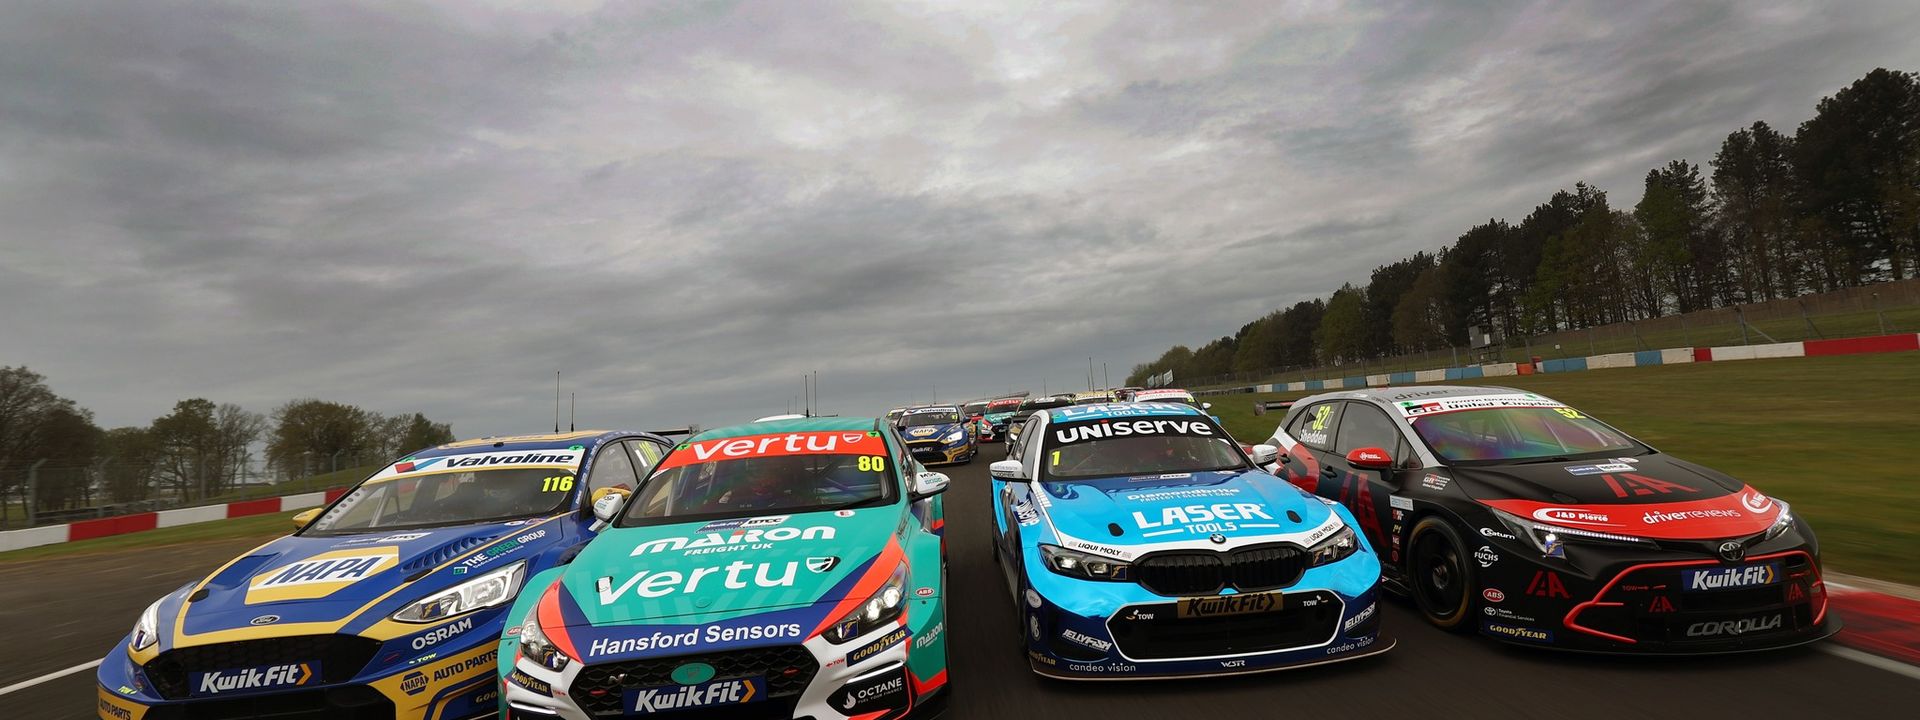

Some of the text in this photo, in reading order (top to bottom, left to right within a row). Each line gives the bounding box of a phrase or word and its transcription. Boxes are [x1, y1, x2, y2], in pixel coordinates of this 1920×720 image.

[1106, 408, 1149, 417] TOOLS
[1311, 405, 1331, 431] 52
[1553, 407, 1586, 419] 52
[446, 452, 575, 469] Valvoline
[857, 455, 886, 473] 80
[1051, 450, 1061, 466] 1
[542, 476, 575, 493] 116
[1132, 503, 1275, 530] LASER
[1555, 511, 1576, 519] J&D
[1578, 513, 1609, 522] Pierce
[1185, 521, 1238, 535] TOOLS
[1486, 529, 1516, 541] Saturn
[461, 529, 546, 567] THE GREEN GROUP
[683, 544, 748, 557] FREIGHT
[1077, 542, 1122, 556] LIQUI MOLY
[1474, 552, 1499, 562] FUCHS
[263, 556, 382, 586] NAPA
[1302, 599, 1317, 607] TOW
[1486, 591, 1502, 600] ABS
[1489, 624, 1548, 640] GOODYEAR
[1686, 614, 1782, 636] COROLLA
[411, 617, 473, 650] OSRAM
[588, 622, 801, 657] Hansford Sensors
[1062, 629, 1112, 651] JELLYFISH
[852, 629, 907, 661] GOODYEAR
[1326, 643, 1355, 655] candeo
[417, 652, 437, 663] TOW
[433, 649, 498, 682] AUTO PARTS
[1069, 662, 1136, 672] candeo vision
[403, 676, 427, 692] NAPA
[511, 671, 549, 693] GOODYEAR
[857, 677, 903, 699] OCTANE
